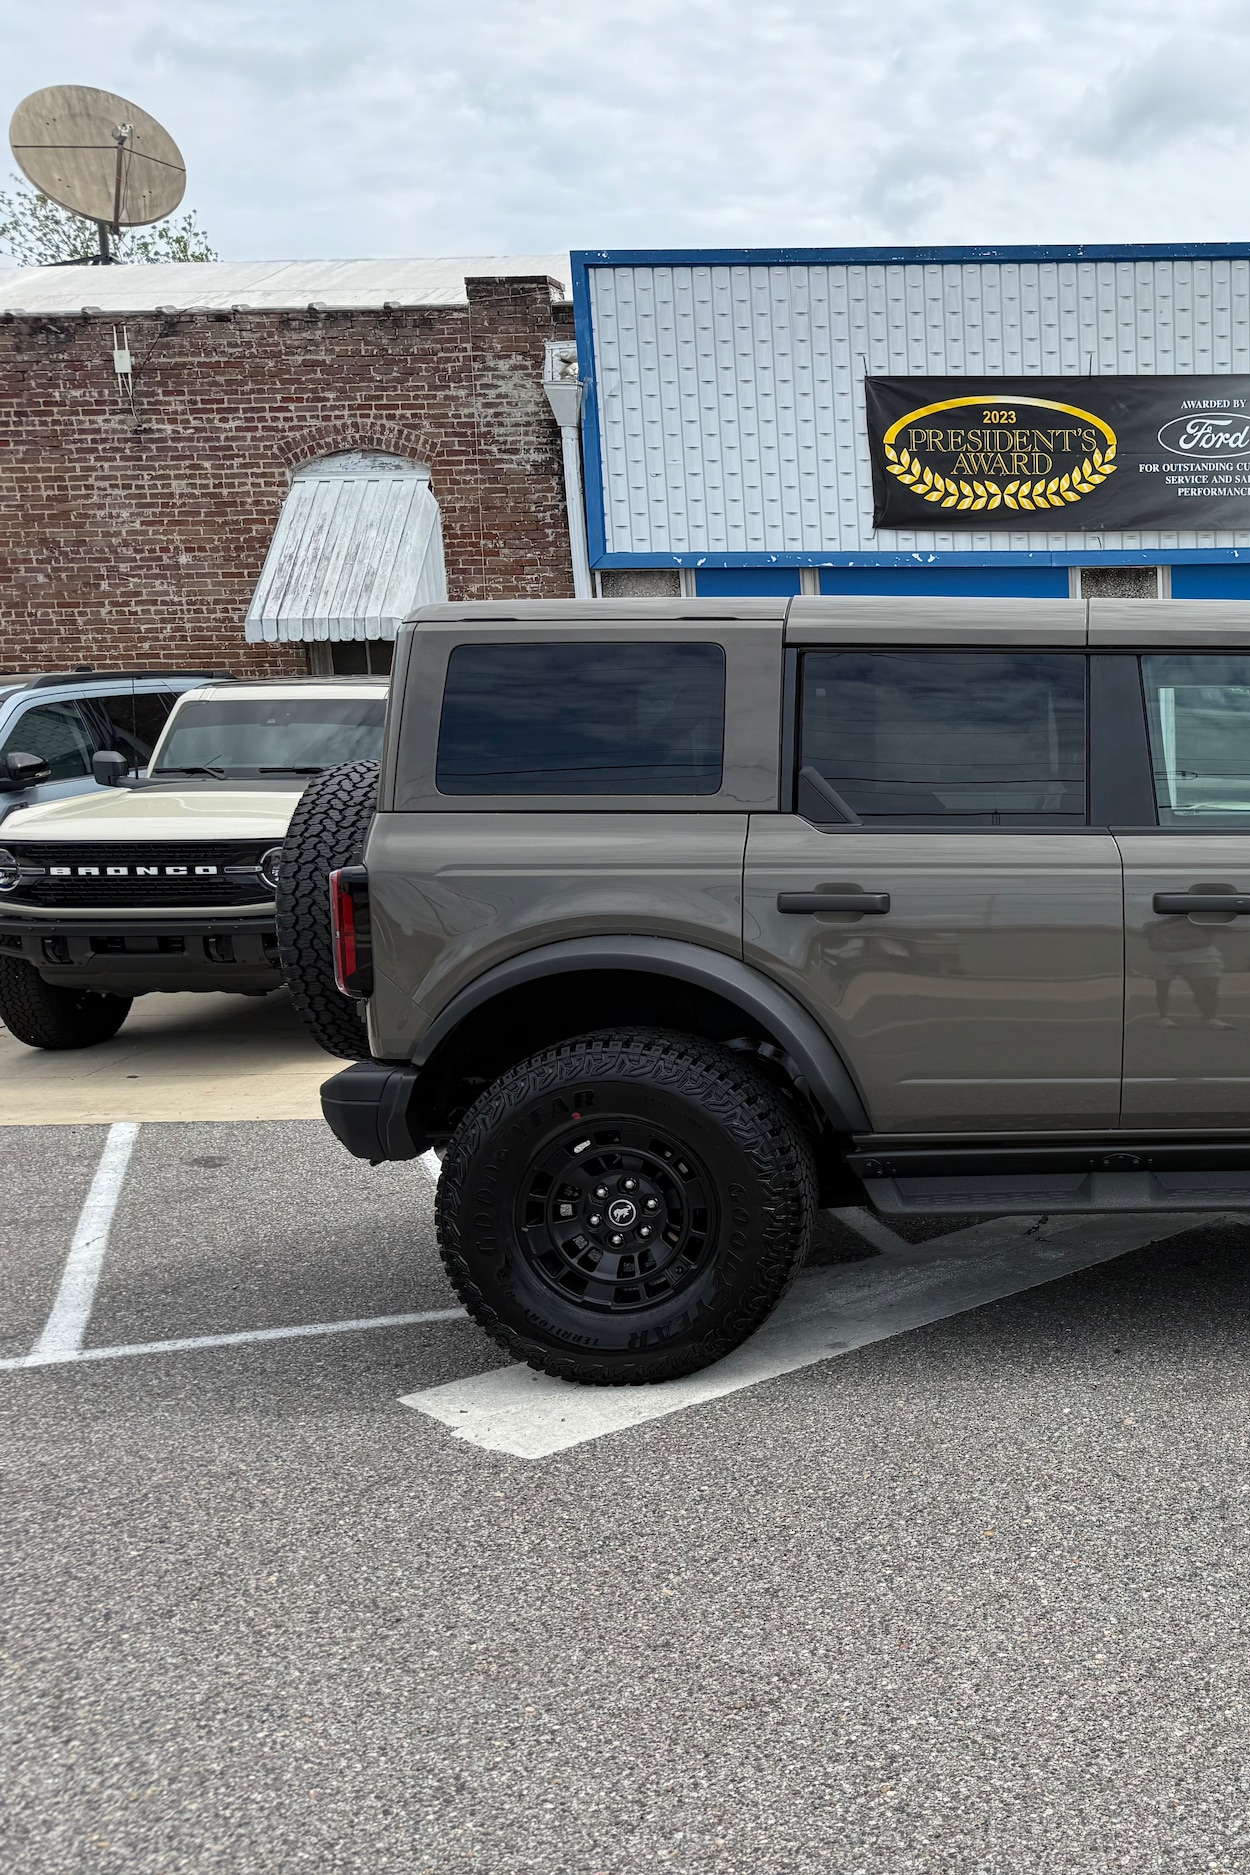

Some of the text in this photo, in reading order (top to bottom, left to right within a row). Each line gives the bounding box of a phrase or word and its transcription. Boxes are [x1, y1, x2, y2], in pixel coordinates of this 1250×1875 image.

[1181, 399, 1247, 409] AWARDED BY
[982, 411, 1017, 424] 2023
[908, 428, 1097, 452] PRESIDENT'S
[1178, 419, 1250, 450] Ford
[950, 453, 1053, 475] AWARD
[1139, 464, 1160, 473] FOR
[1162, 463, 1234, 472] OUTSTANDING
[1165, 475, 1208, 484] SERVICE
[1211, 475, 1232, 484] AND
[49, 866, 218, 876] BRONCO
